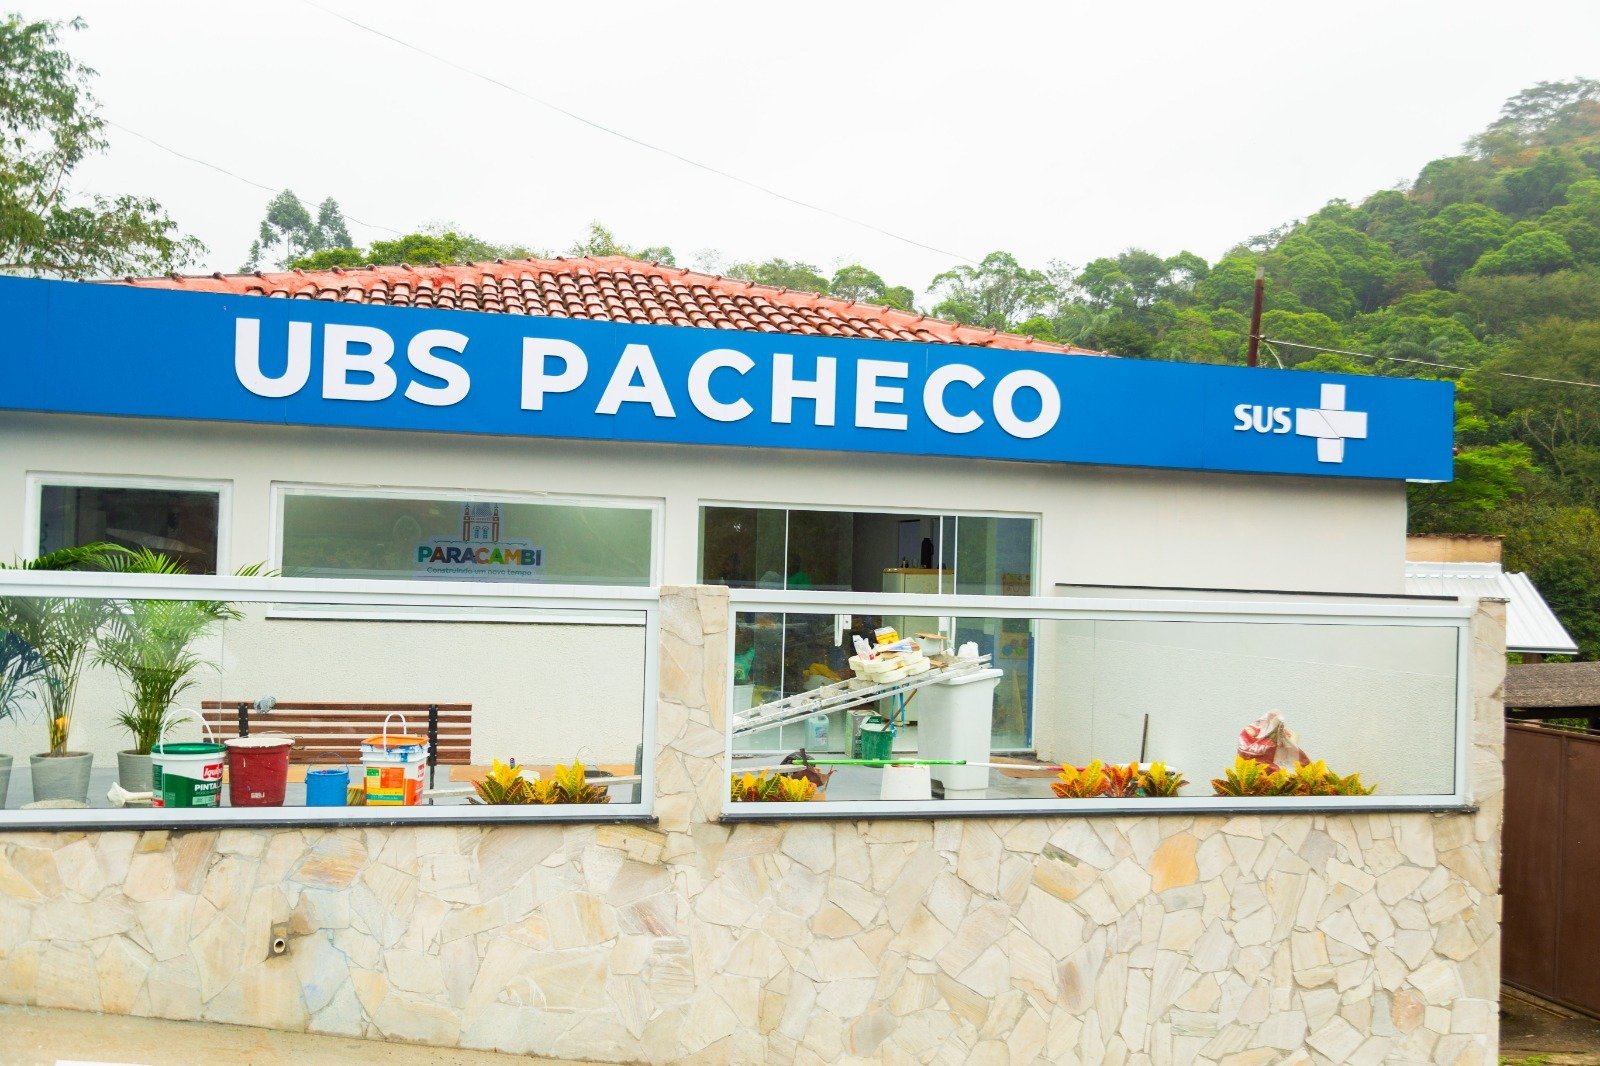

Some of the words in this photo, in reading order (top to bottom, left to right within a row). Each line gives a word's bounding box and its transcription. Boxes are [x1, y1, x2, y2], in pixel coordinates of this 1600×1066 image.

[234, 317, 471, 407] UBS
[520, 336, 1062, 440] PACHECO
[1234, 404, 1292, 434] SUS
[417, 546, 542, 566] PARACAMBI
[426, 567, 472, 575] Construindo
[507, 568, 532, 577] tempo
